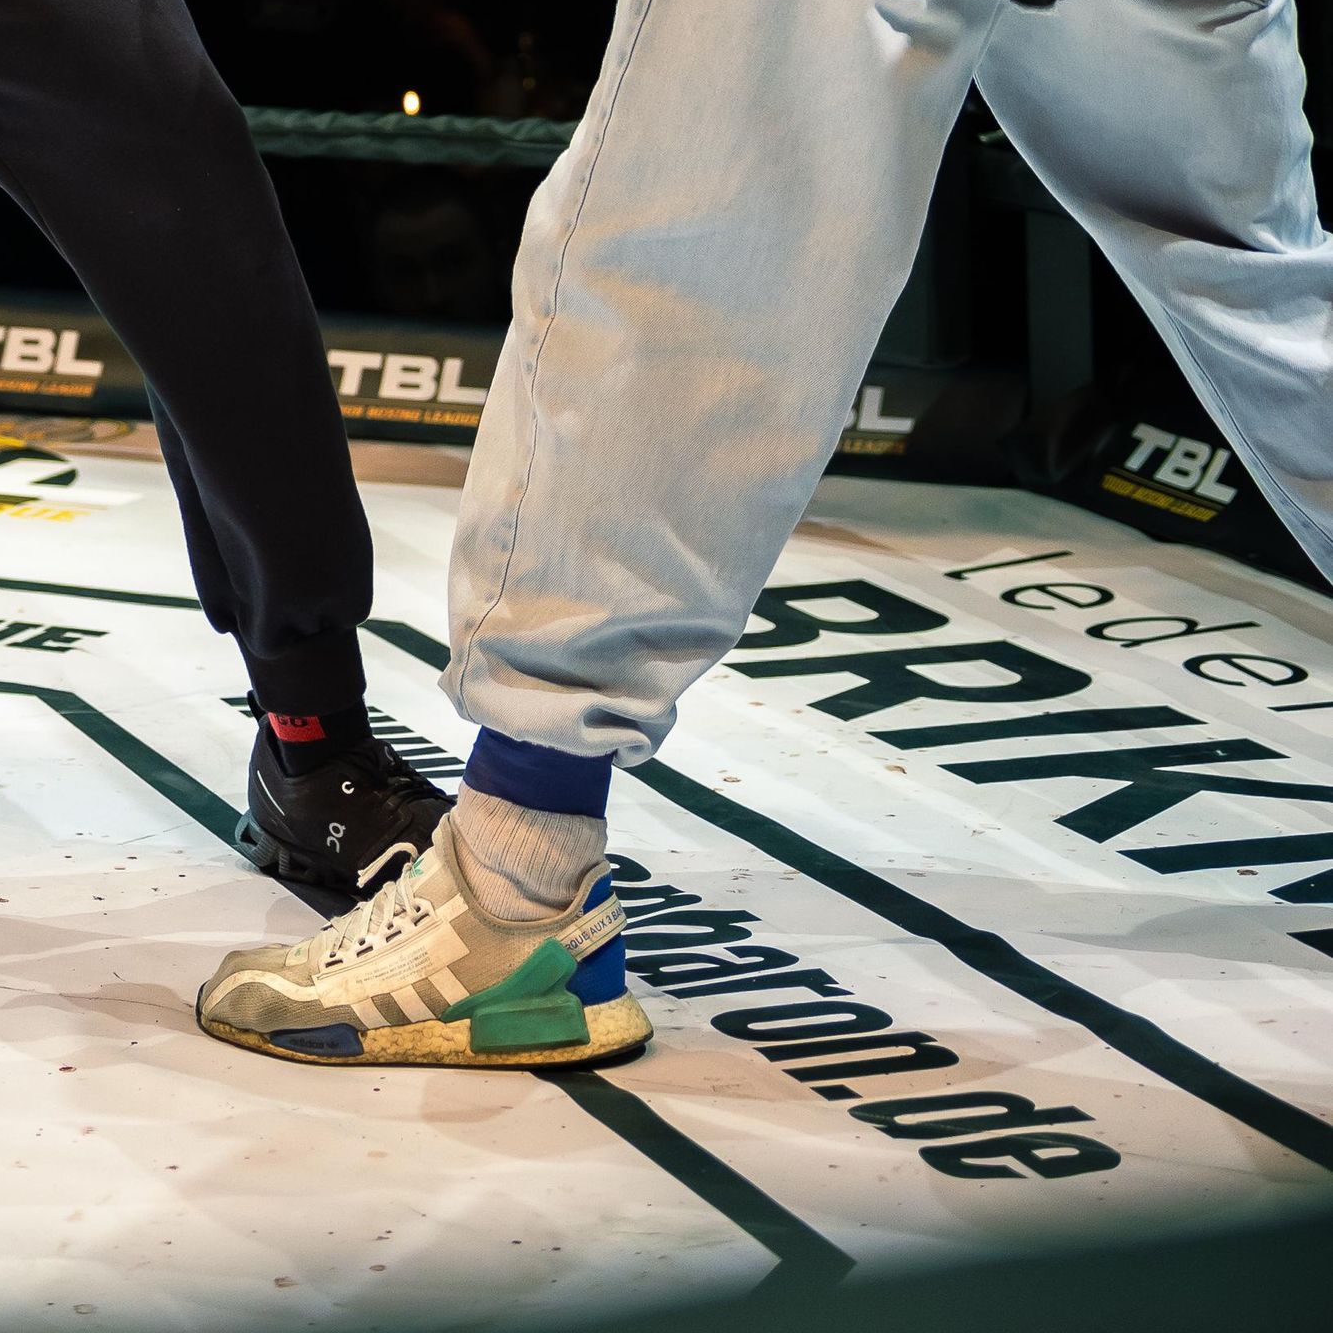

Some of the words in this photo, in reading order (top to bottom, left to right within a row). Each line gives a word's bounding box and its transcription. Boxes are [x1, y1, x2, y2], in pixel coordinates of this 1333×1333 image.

[327, 349, 489, 405] TBL
[1123, 423, 1238, 505] TBL
[589, 918, 607, 936] AUX
